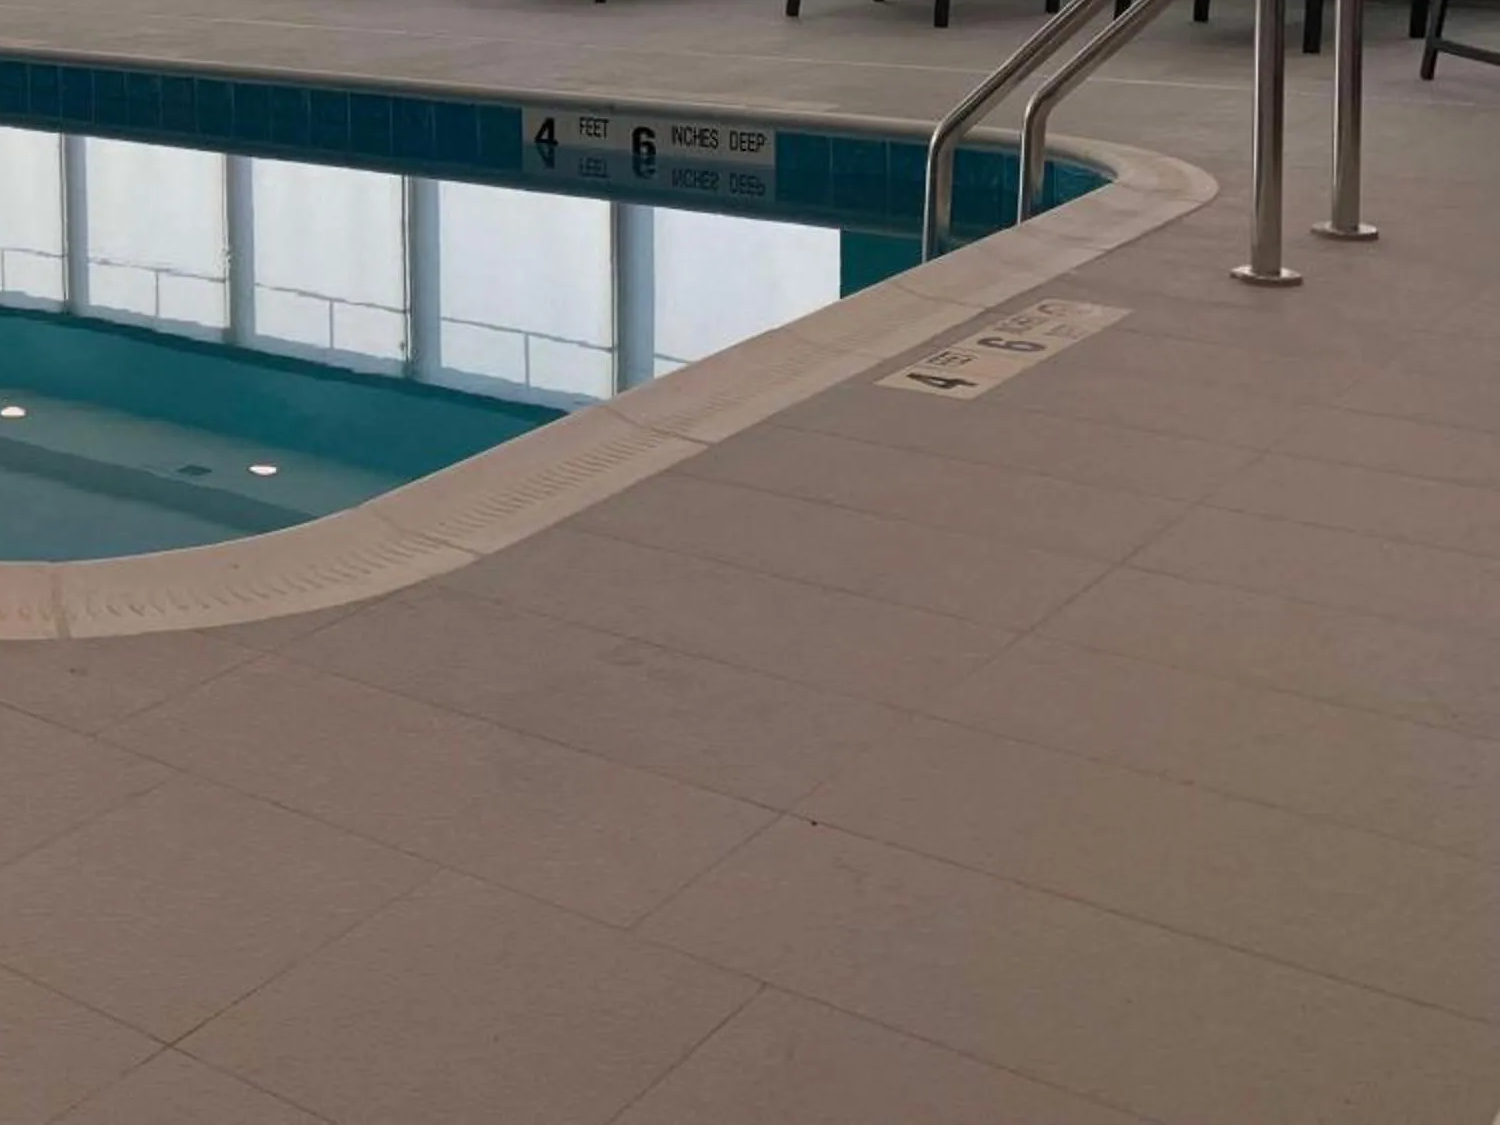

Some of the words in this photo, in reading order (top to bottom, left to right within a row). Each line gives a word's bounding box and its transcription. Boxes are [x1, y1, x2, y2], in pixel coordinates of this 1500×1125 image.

[535, 118, 558, 146] 4
[580, 116, 609, 139] FEET
[631, 126, 657, 159] 6
[671, 125, 719, 151] INCHES
[729, 130, 767, 153] DEEP
[906, 372, 980, 390] 4
[976, 337, 1047, 352] 6
